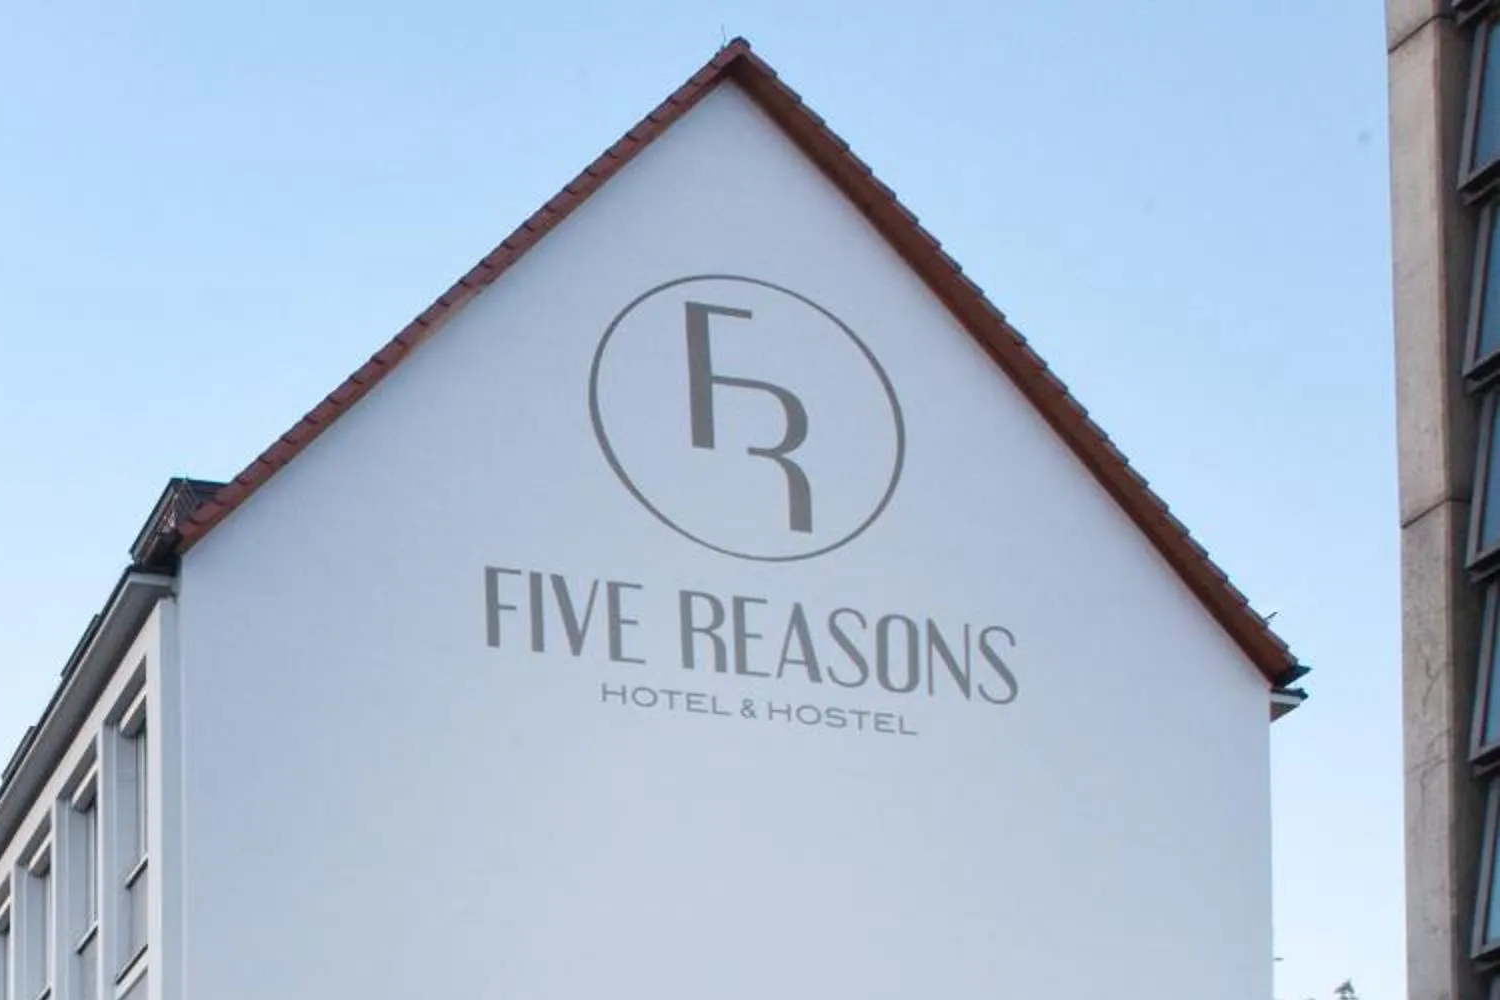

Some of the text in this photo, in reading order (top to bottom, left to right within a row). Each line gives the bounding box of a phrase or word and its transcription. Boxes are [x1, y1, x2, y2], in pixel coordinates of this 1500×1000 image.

[483, 564, 1019, 706] FIVE REASONS
[601, 682, 733, 718] HOTEL
[767, 701, 918, 738] HOSTEL
